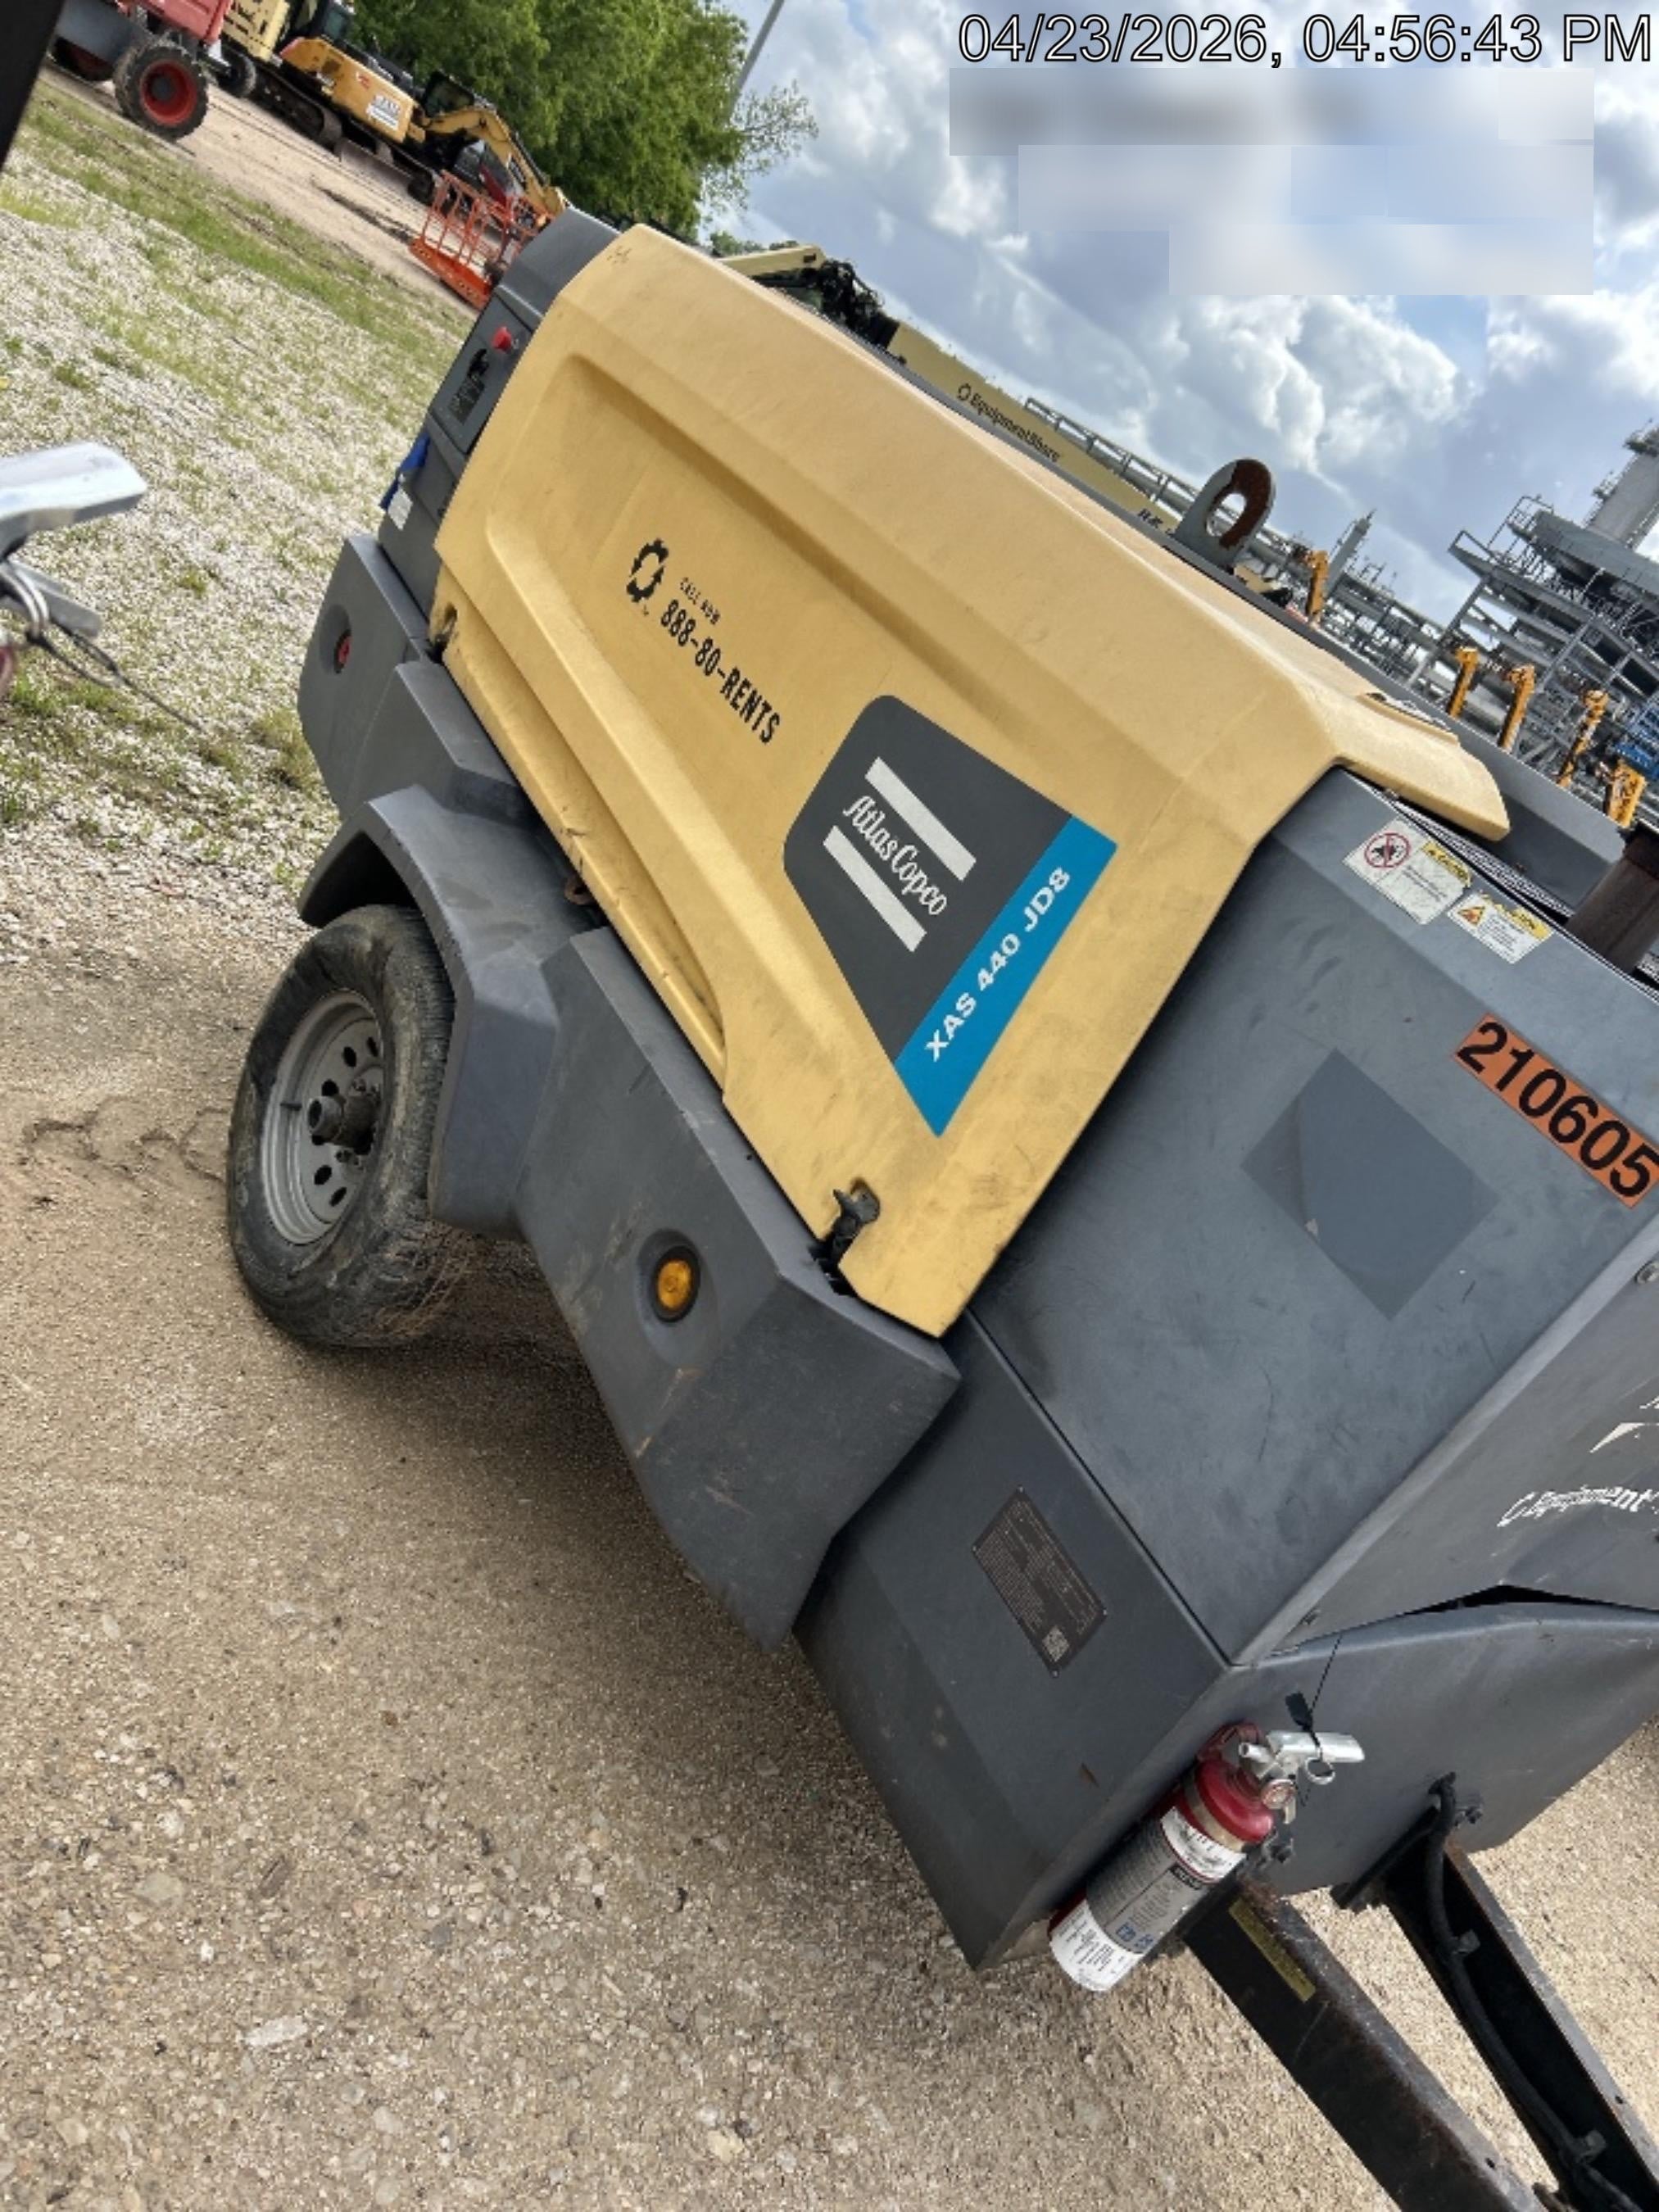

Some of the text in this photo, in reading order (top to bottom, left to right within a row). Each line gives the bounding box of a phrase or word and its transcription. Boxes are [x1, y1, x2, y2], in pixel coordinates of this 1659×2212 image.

[660, 599, 781, 744] 888-80-RENTS
[842, 796, 947, 915] Atlas Copco
[926, 867, 1071, 1061] XAS 440 JD8
[1456, 1021, 1659, 1197] 210605
